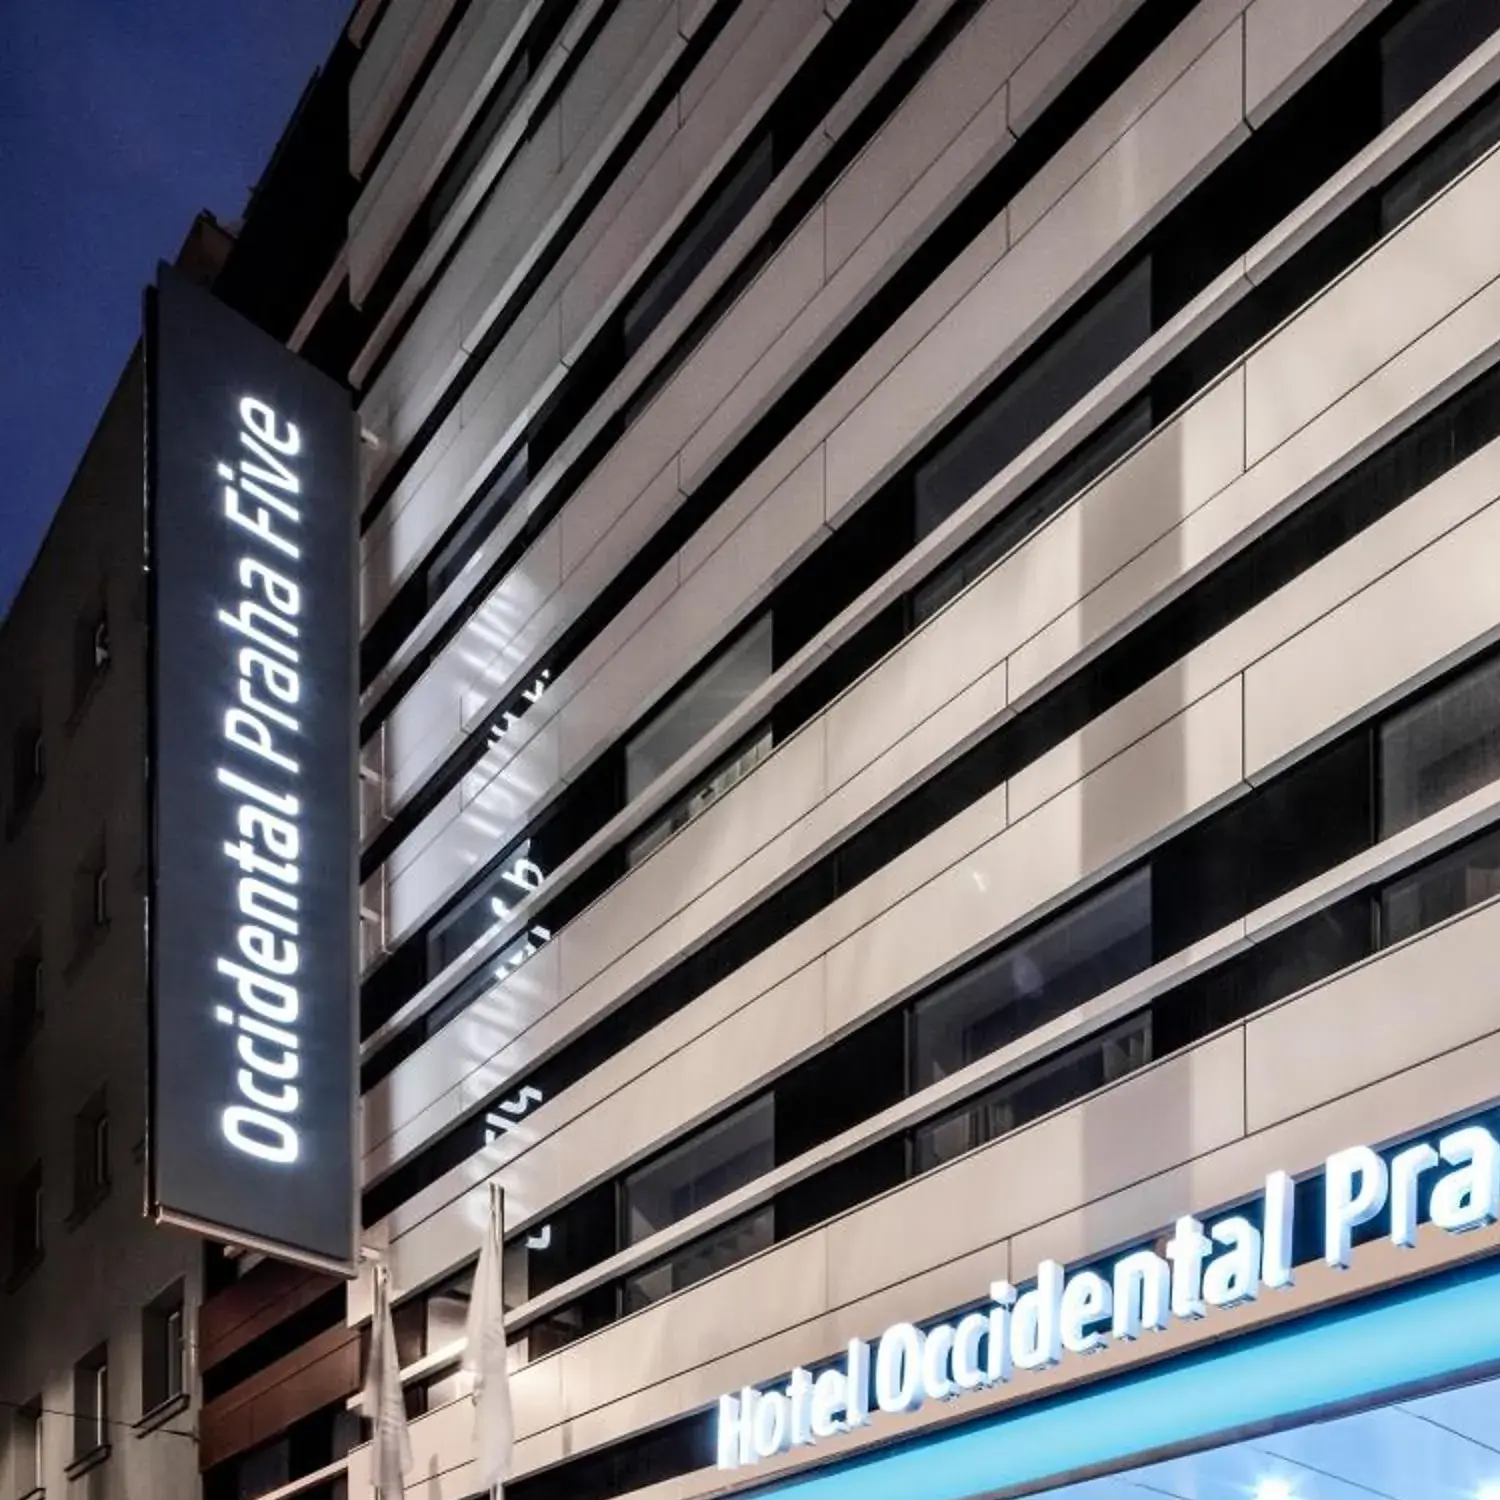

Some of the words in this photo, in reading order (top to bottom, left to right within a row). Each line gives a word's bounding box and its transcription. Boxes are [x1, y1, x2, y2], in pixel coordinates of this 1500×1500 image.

[217, 396, 302, 560] Five
[217, 556, 301, 775] Praha
[215, 767, 301, 1164] Occidental
[716, 1337, 871, 1471] Hotel
[875, 1169, 1295, 1414] Occidental
